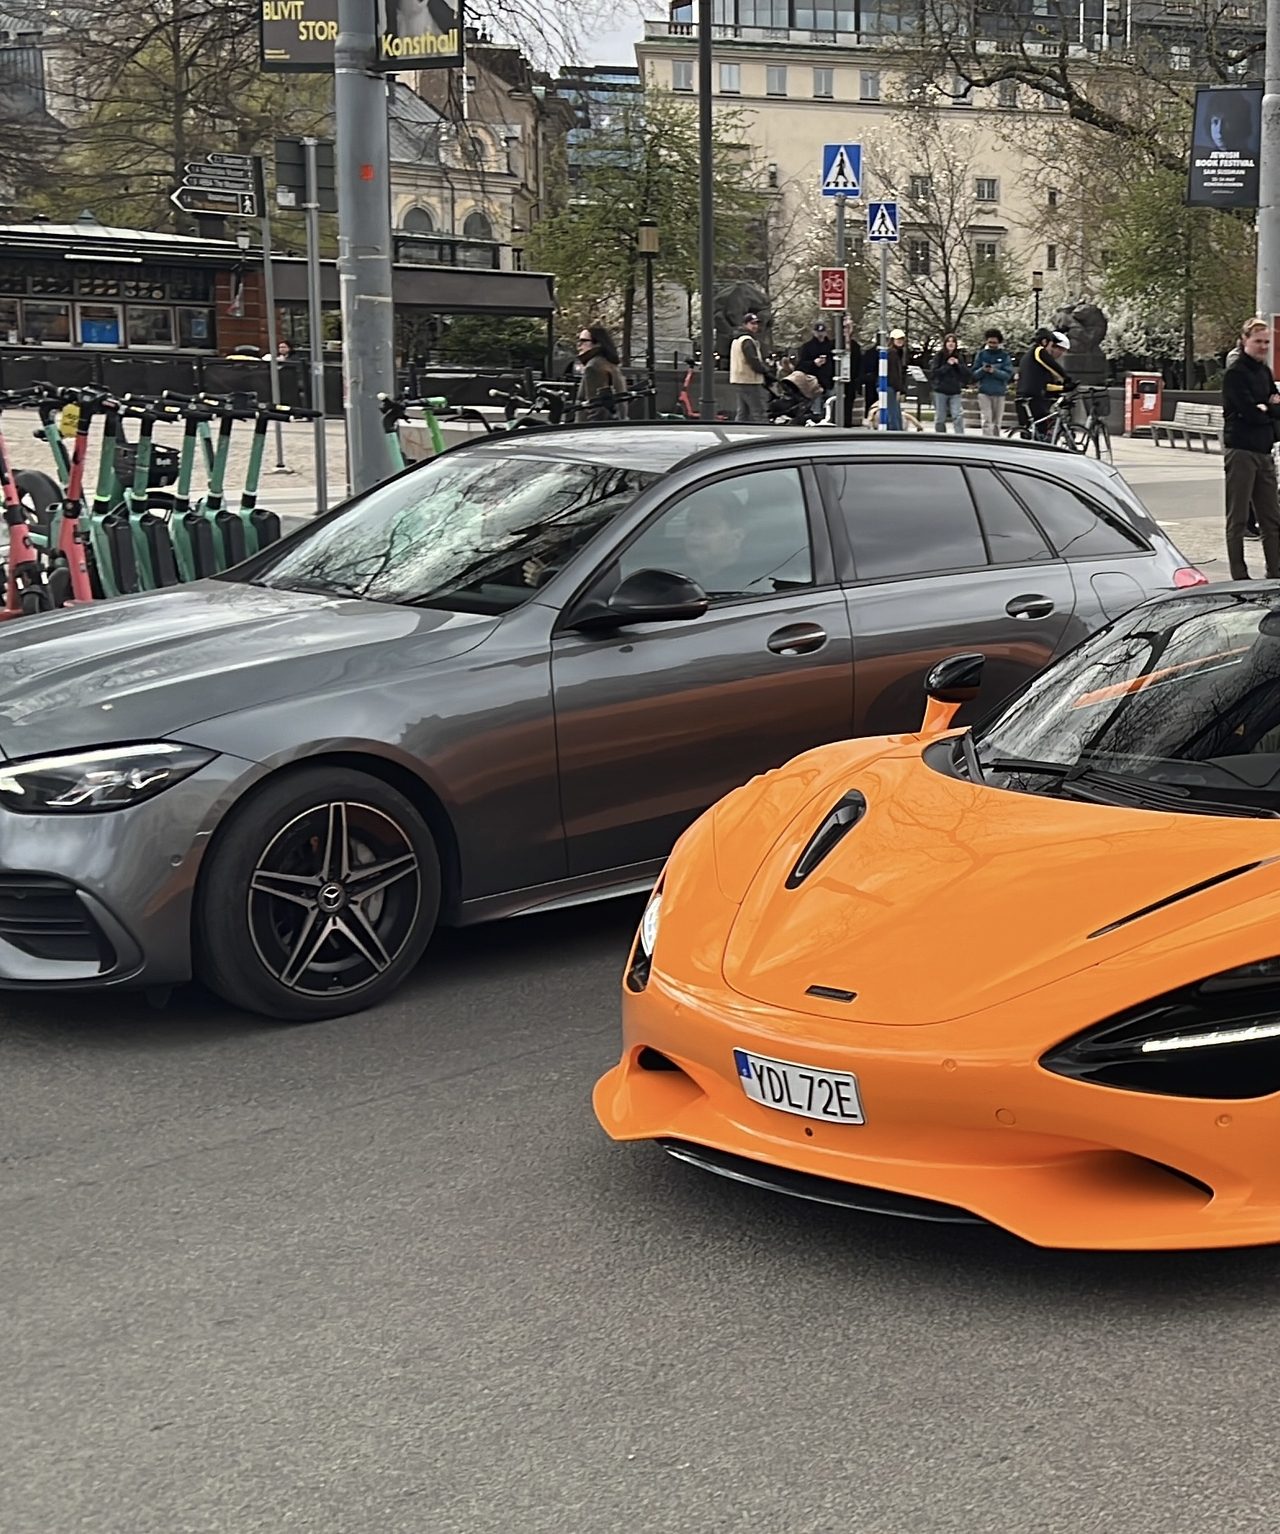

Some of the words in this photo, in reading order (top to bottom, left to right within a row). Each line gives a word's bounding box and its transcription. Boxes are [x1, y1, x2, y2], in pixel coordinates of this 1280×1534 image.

[263, 1, 304, 20] BLIVIT
[299, 21, 338, 41] STOR
[381, 28, 458, 57] Konsthall
[1195, 159, 1218, 167] BOOK
[1219, 159, 1255, 167] FESTIVAL
[1210, 151, 1240, 159] JEWISH
[751, 1062, 858, 1118] YDL72E
